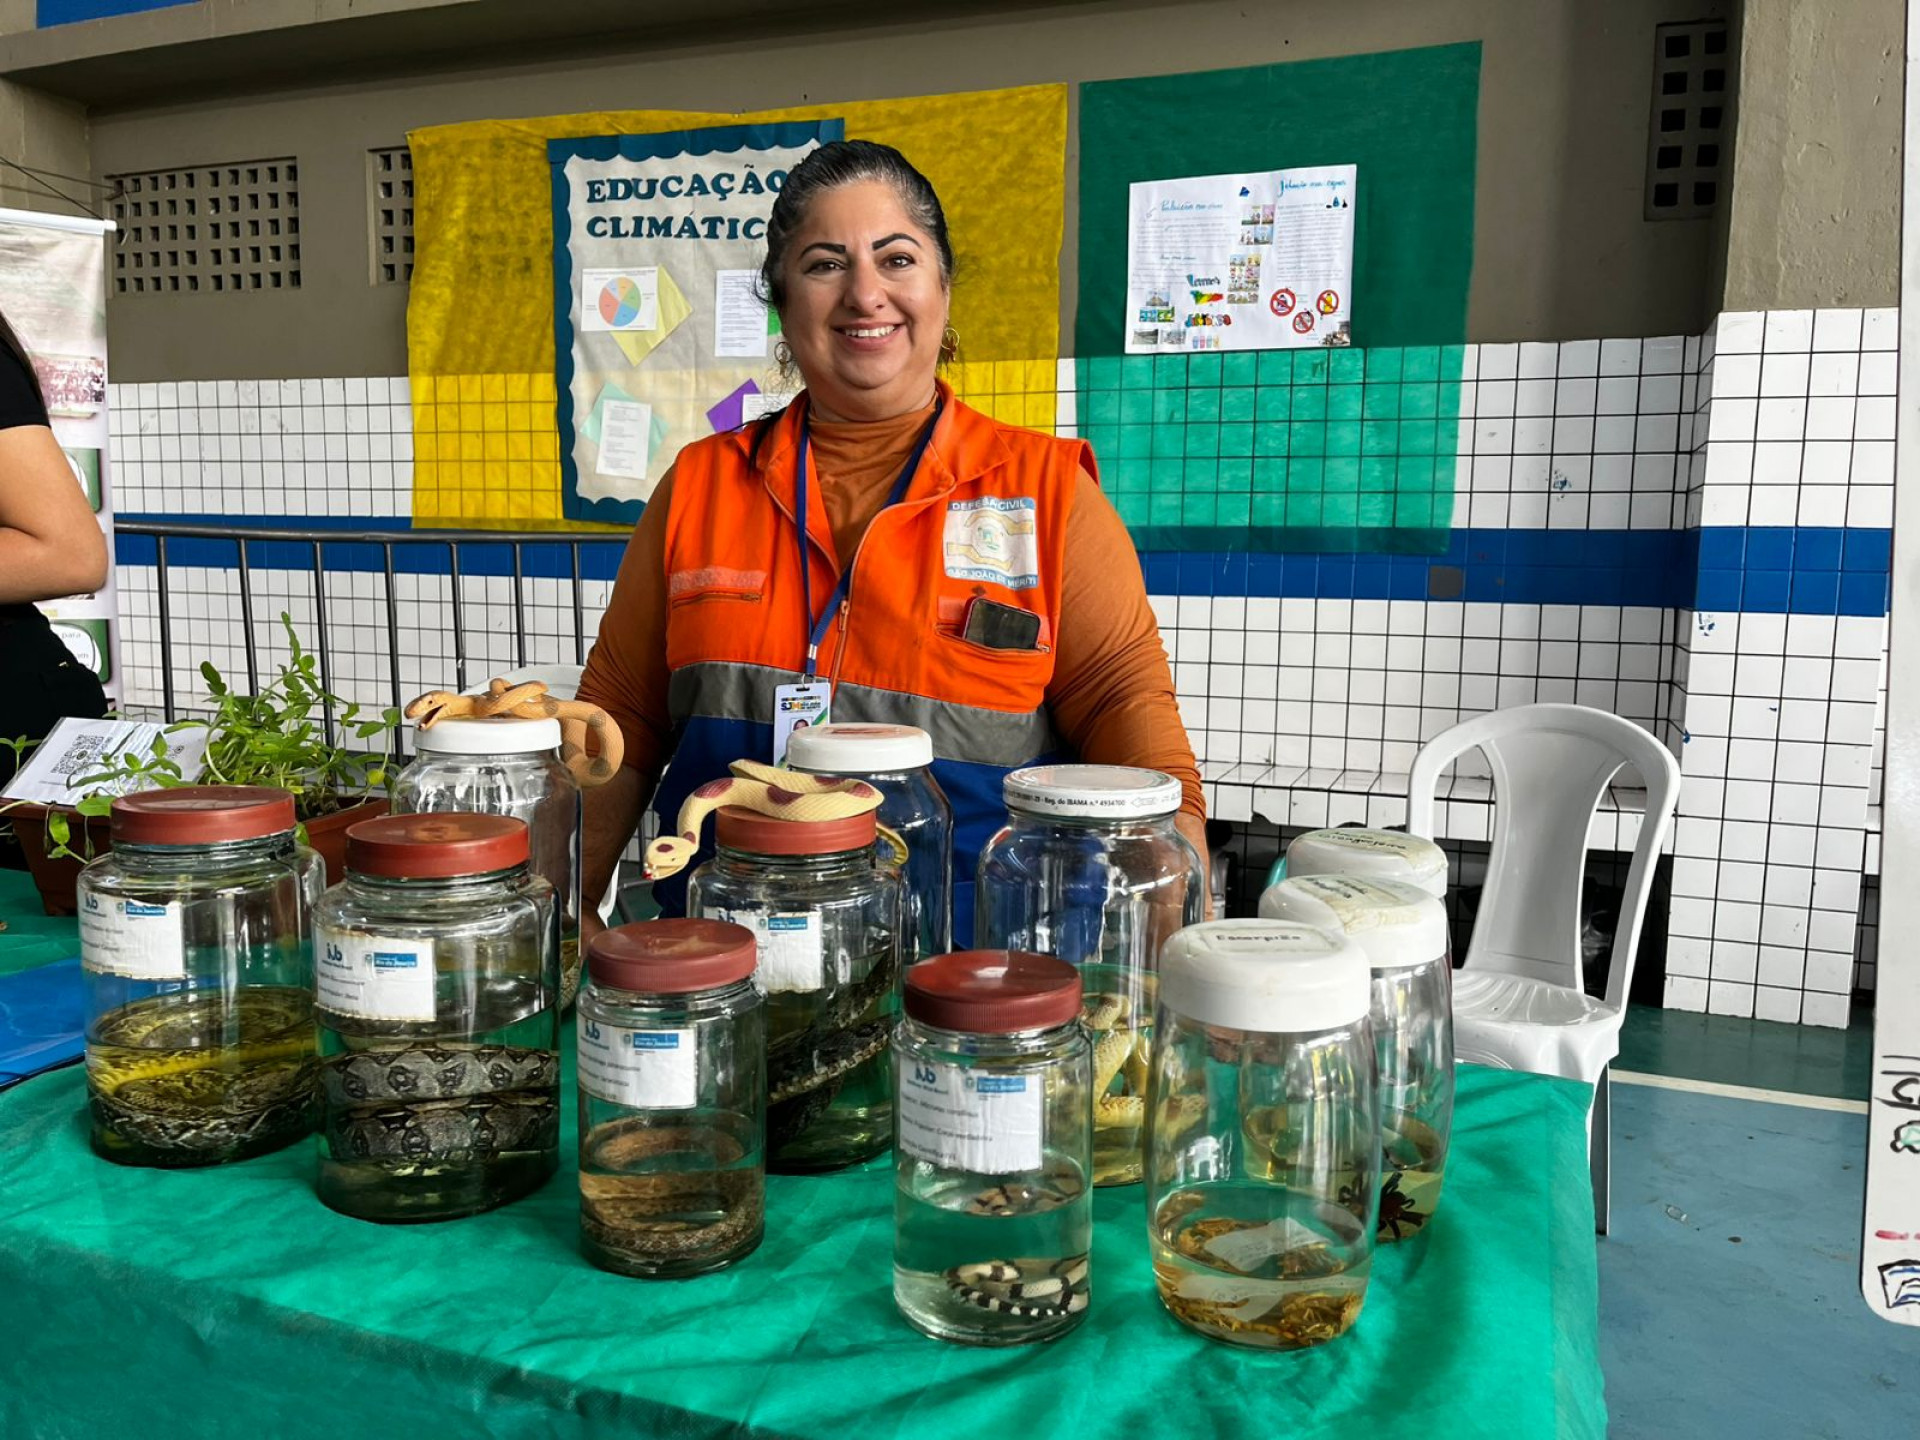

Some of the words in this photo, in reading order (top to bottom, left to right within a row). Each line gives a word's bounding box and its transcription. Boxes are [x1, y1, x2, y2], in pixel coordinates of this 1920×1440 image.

[586, 162, 788, 203] EDUCAÇÃO
[586, 211, 766, 240] CLIMÁTIC
[999, 500, 1026, 510] CIVIL
[1007, 577, 1037, 588] MERITI
